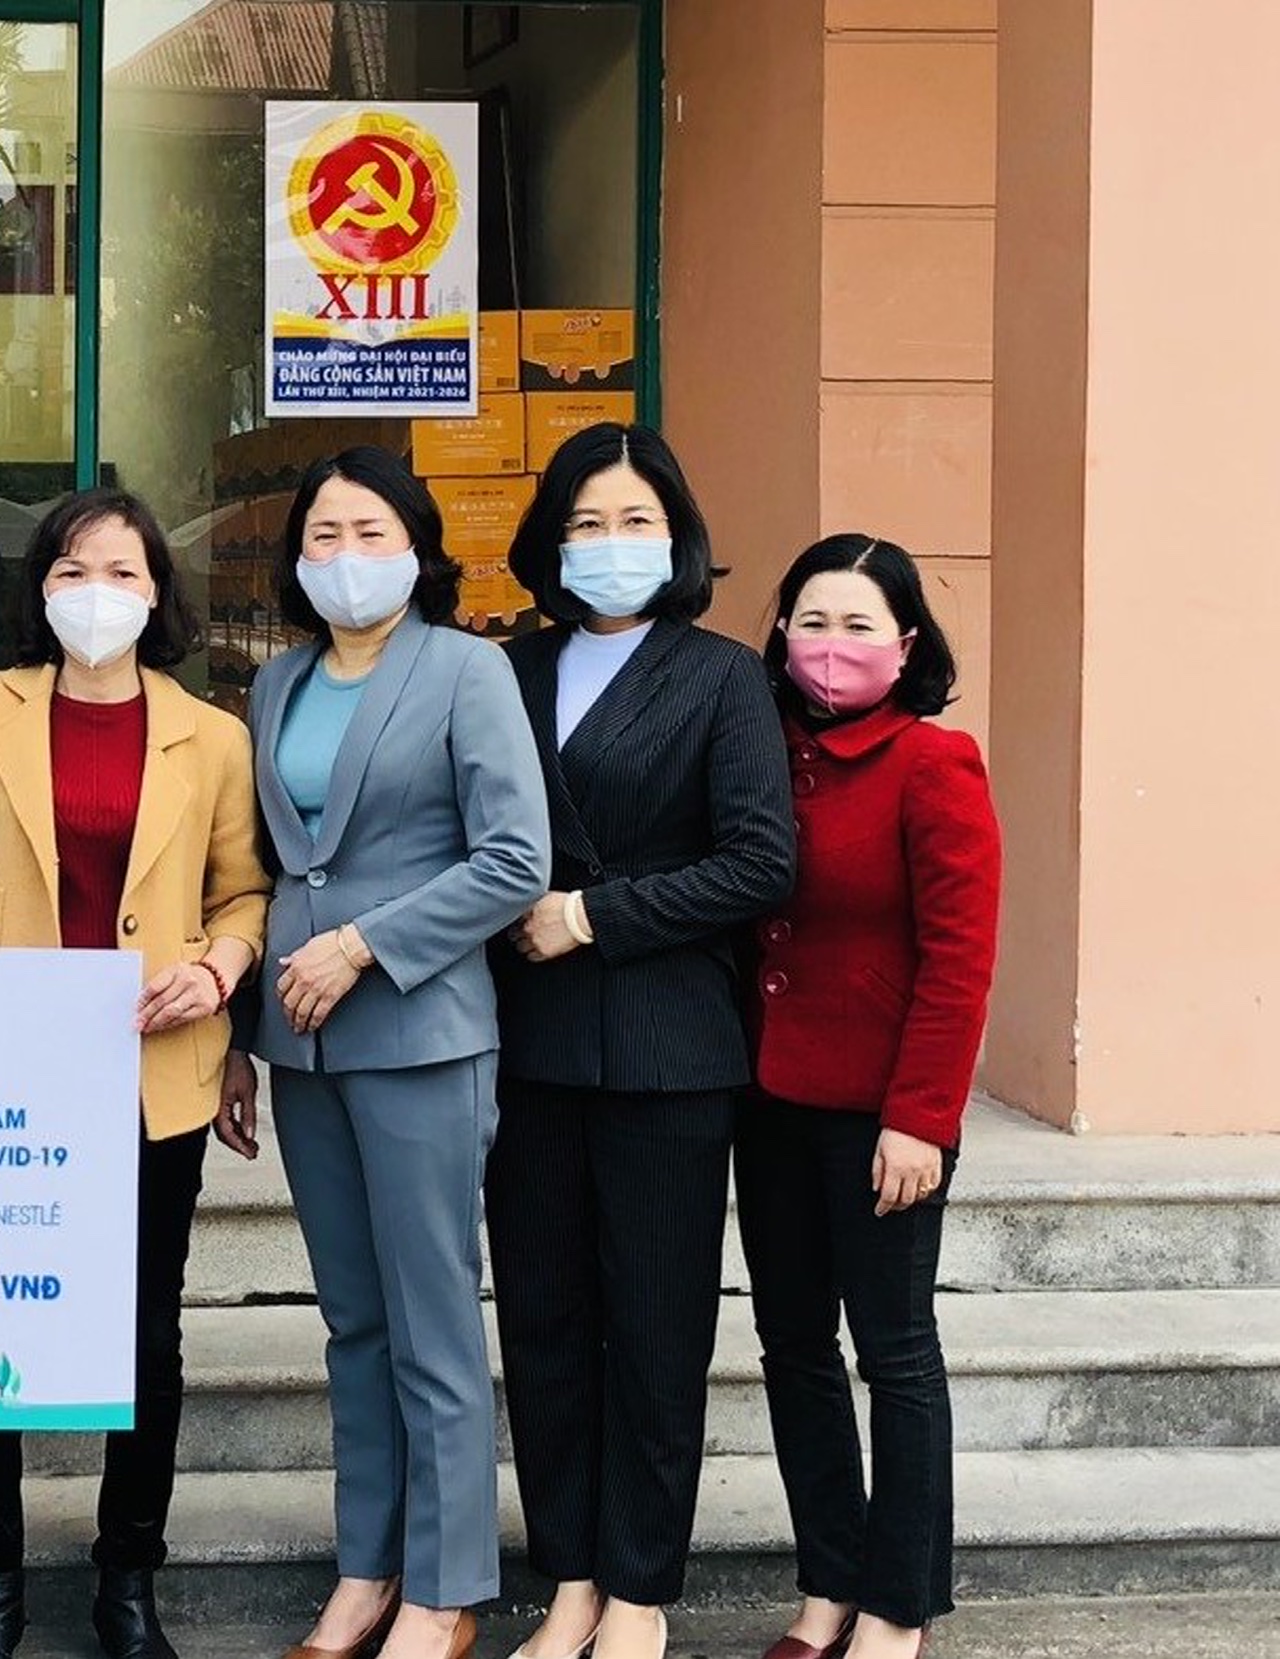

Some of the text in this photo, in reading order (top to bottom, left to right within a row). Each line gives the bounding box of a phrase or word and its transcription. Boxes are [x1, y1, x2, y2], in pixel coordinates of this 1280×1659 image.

[315, 273, 430, 319] XIII
[279, 349, 314, 362] CHÀO
[317, 349, 357, 361] MỪNG
[360, 350, 381, 364] ĐẠI
[384, 350, 407, 364] HỘI
[410, 350, 432, 365] ĐẠI
[279, 364, 466, 388] ĐẢNG CỘNG SẢN VIỆT NAM
[353, 386, 389, 399] NHIỆM
[407, 386, 466, 397] 2021-2026
[0, 1275, 61, 1300] VNĐ
